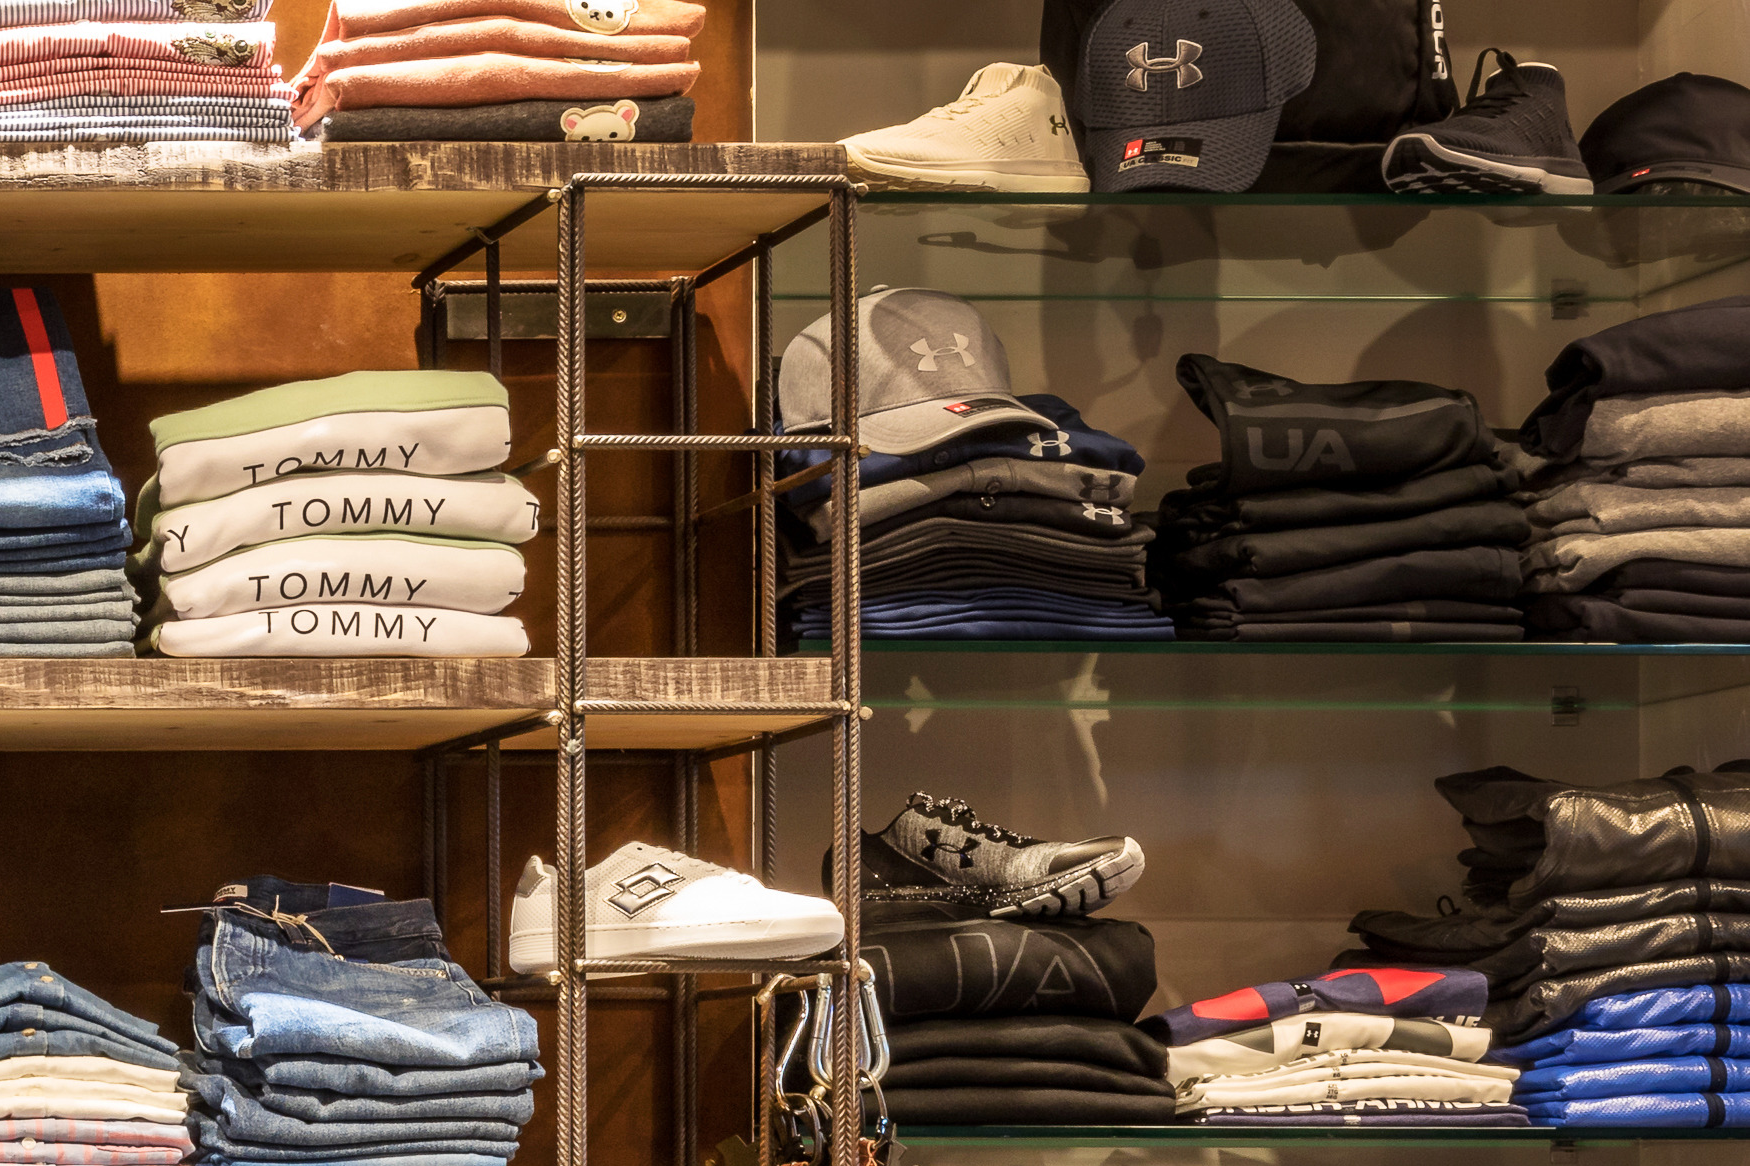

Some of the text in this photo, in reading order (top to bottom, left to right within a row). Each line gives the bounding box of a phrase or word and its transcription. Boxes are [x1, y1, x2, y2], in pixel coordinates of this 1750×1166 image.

[243, 443, 419, 485] TOMMY
[1247, 426, 1356, 471] UA
[272, 498, 445, 530] TOMMY
[249, 572, 427, 602] TOMMY
[259, 609, 436, 642] TOMMY
